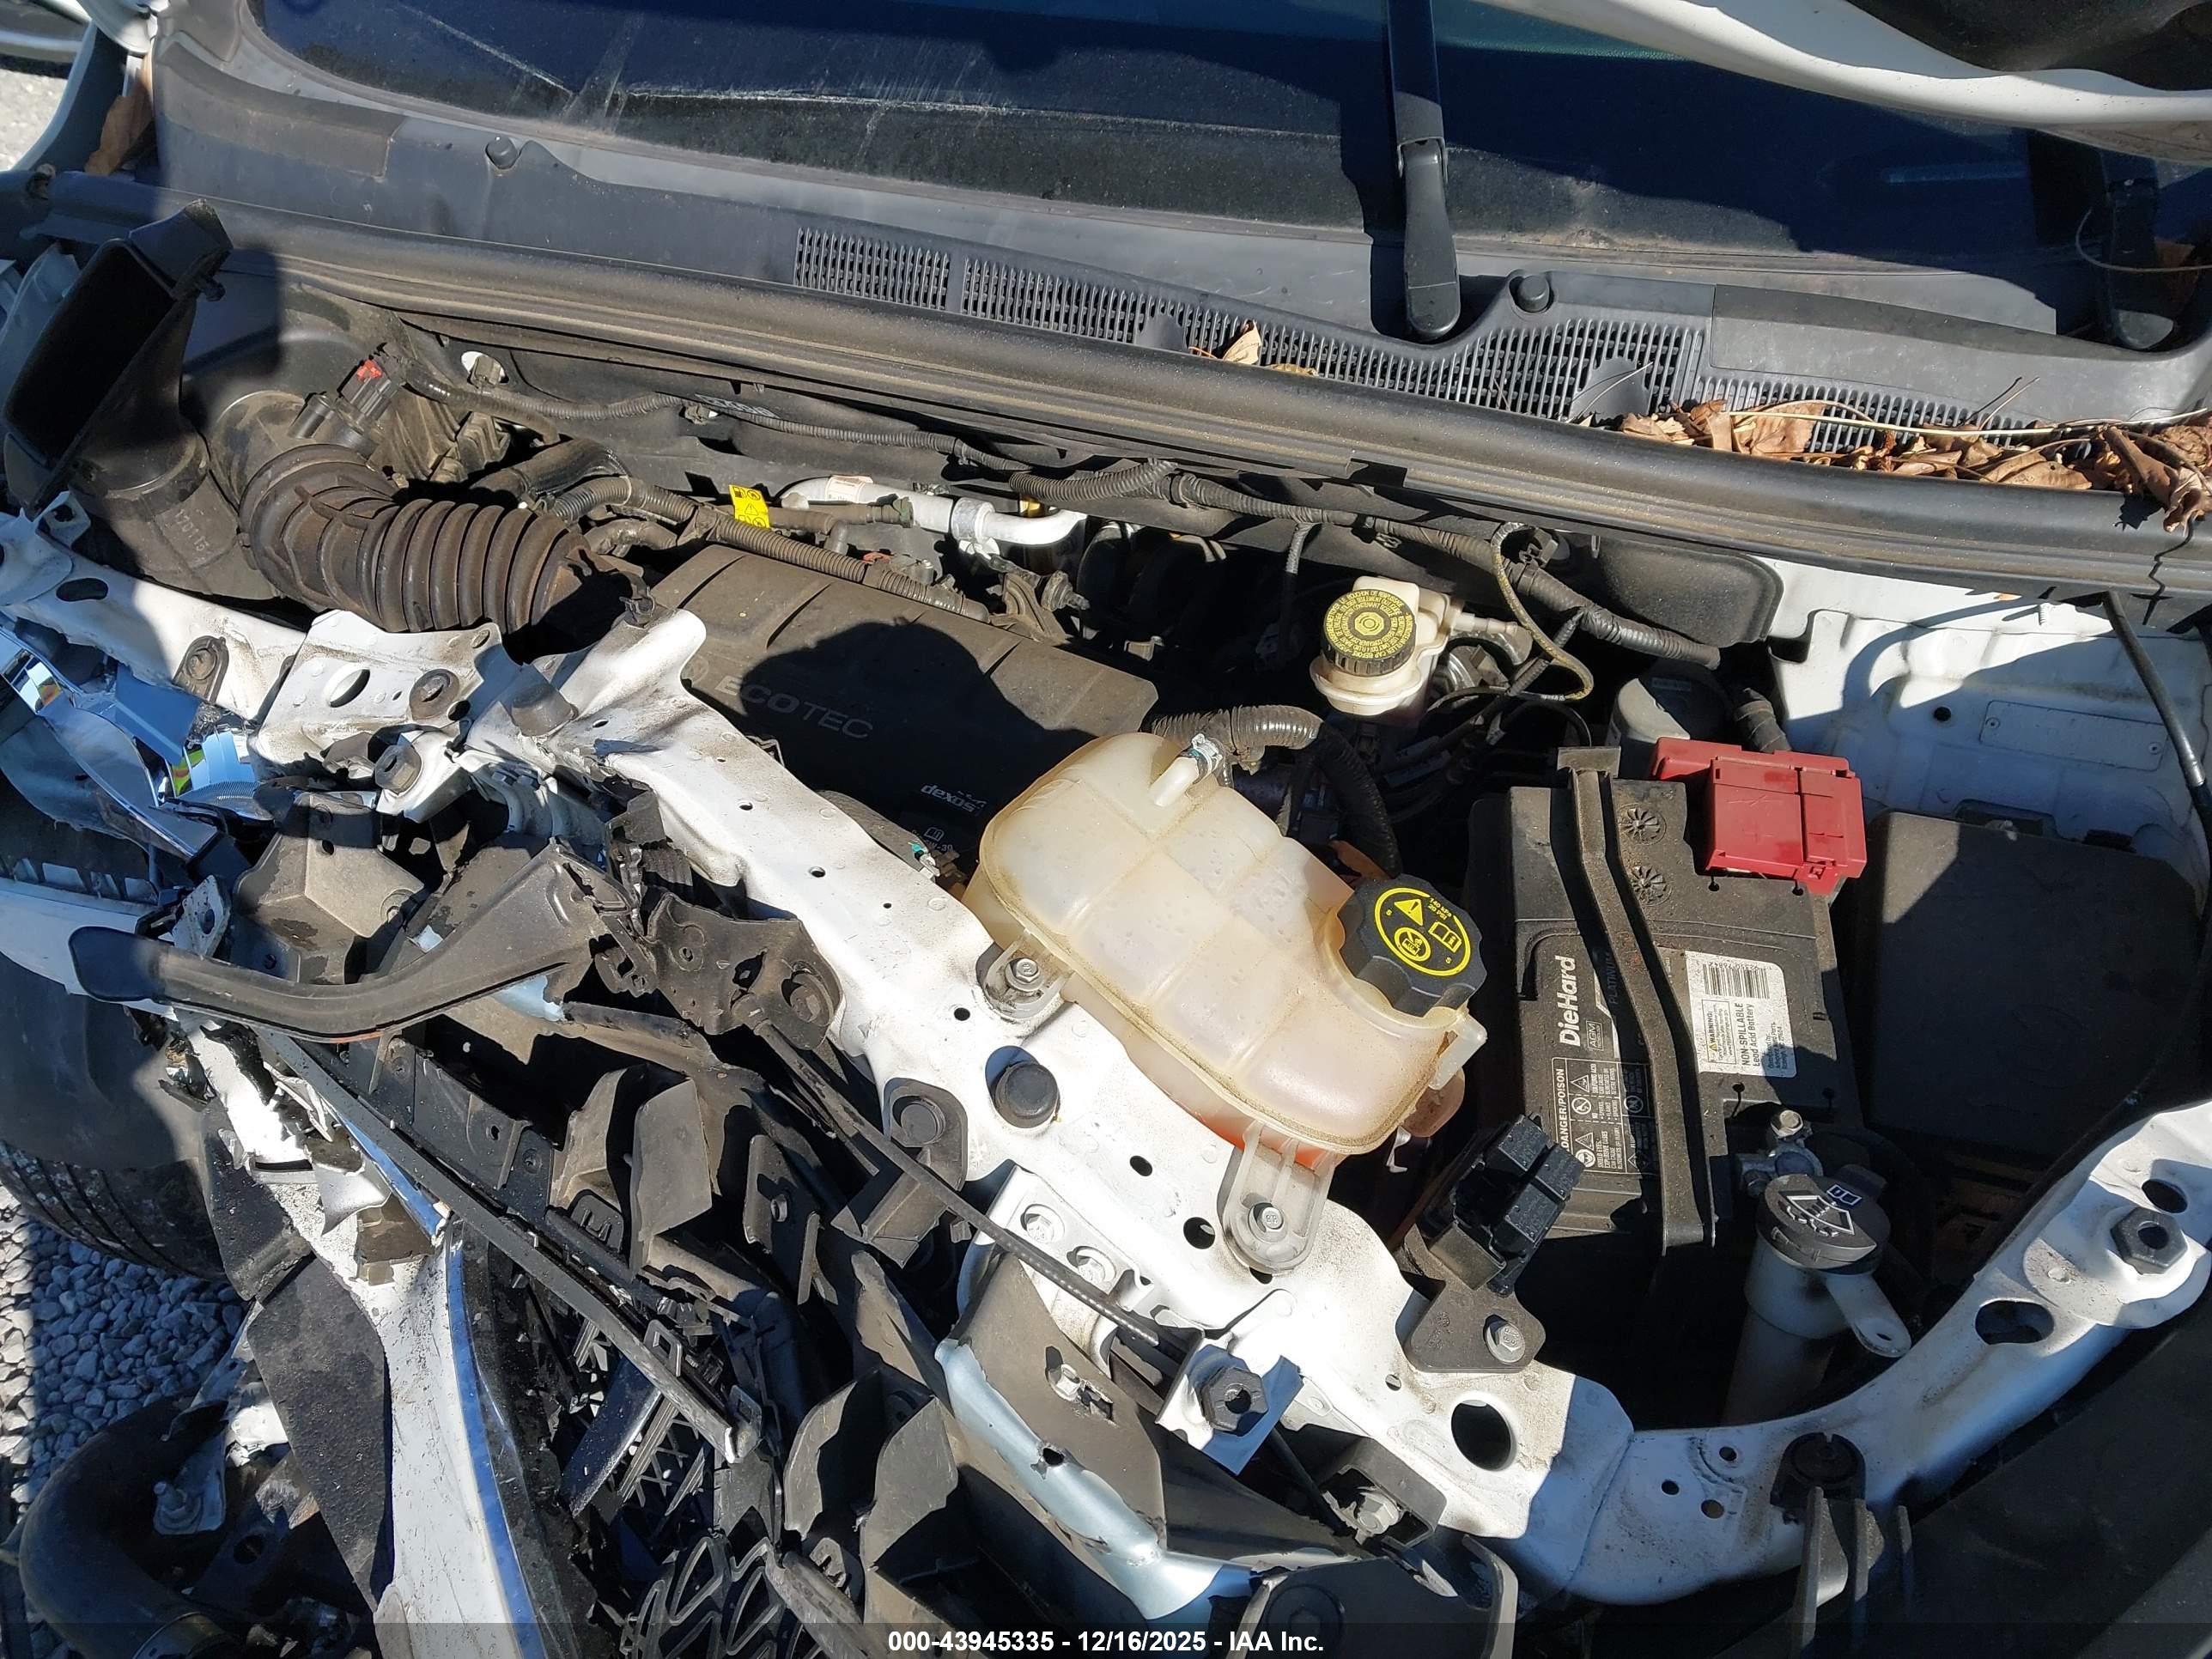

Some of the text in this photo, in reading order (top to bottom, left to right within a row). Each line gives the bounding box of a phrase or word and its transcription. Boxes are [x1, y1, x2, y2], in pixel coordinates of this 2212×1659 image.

[714, 676, 873, 738] ECOTEC
[1431, 898, 1441, 908] 140
[1437, 910, 1447, 920] PSI
[1555, 955, 1580, 1047] DieHard
[1735, 1003, 1750, 1066] NON-SPILLABLE
[1746, 1004, 1760, 1066] Lead Acid Battery
[1556, 1068, 1569, 1148] DANGER/POISON
